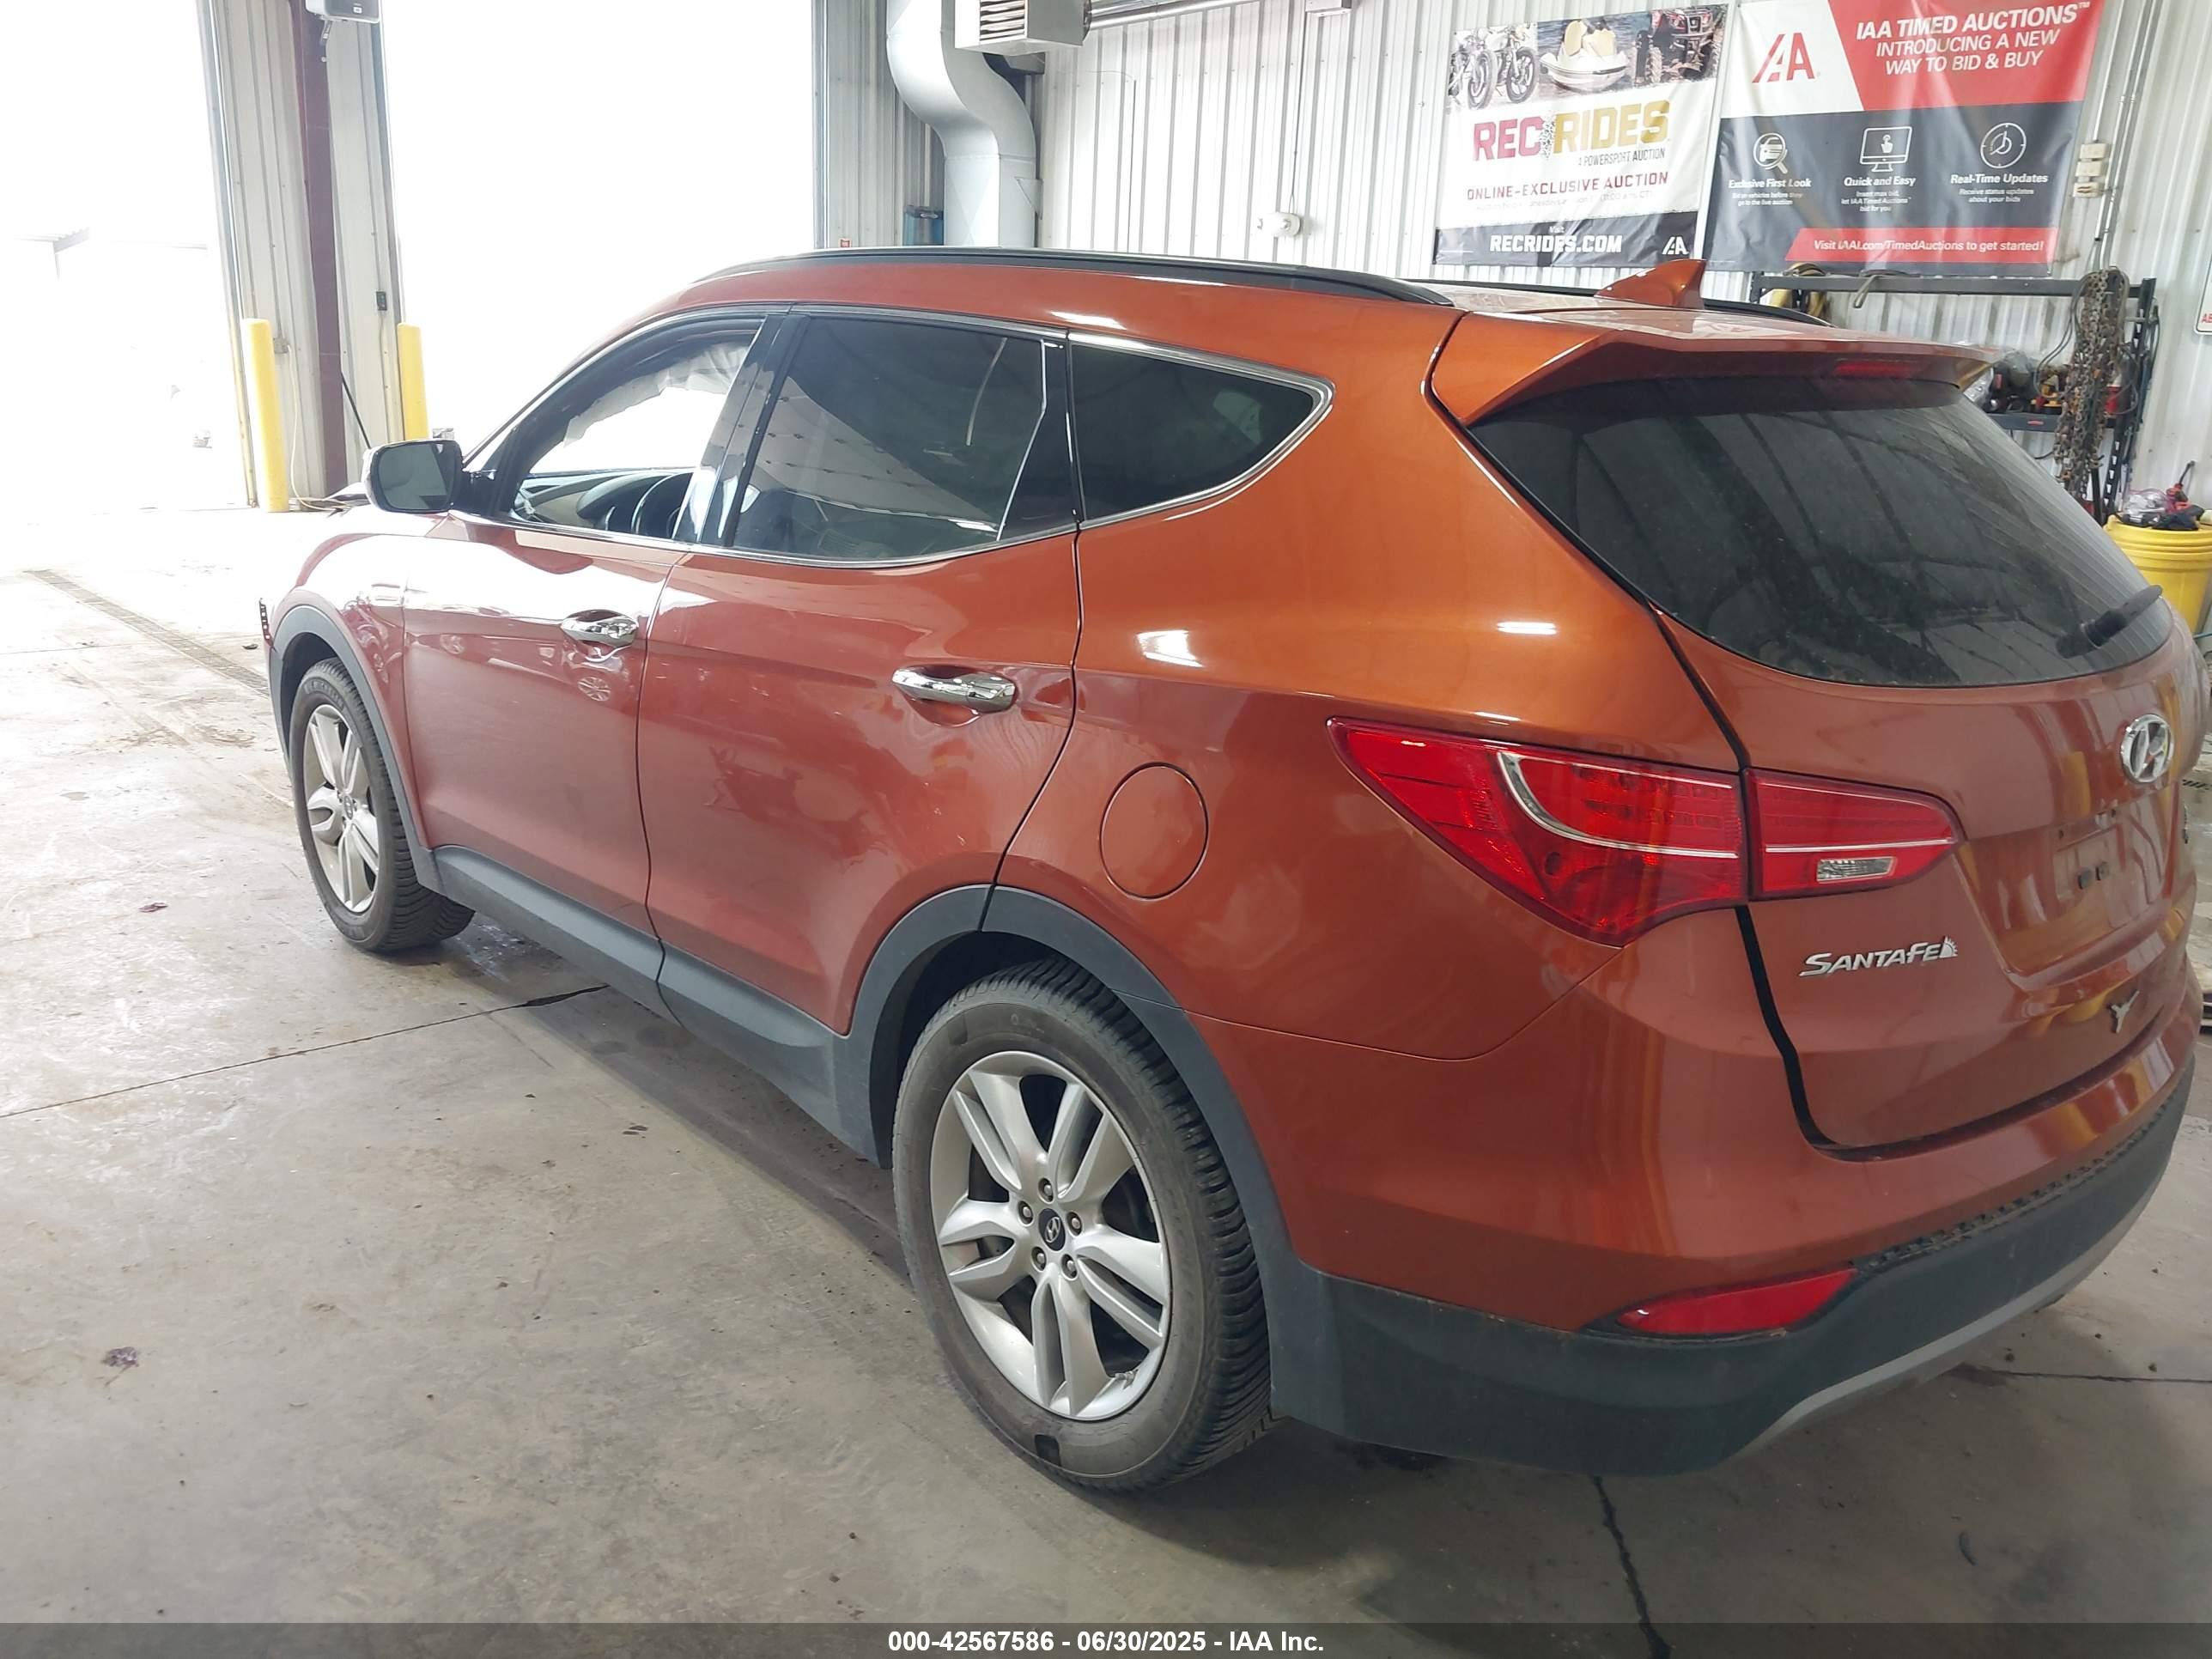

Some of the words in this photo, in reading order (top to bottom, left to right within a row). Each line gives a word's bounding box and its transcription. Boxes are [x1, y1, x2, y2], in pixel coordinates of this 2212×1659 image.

[1856, 21, 1892, 40] IAA
[1897, 15, 1957, 38] TIMED
[1876, 34, 1990, 58] INTRODUCING
[1996, 34, 2009, 49] A
[2014, 28, 2060, 47] NEW
[1886, 58, 1922, 76] WAY
[1926, 57, 1948, 73] TO
[1952, 54, 1981, 70] BID
[1985, 53, 1999, 70] &
[2004, 50, 2044, 68] BUY
[1632, 147, 1666, 161] AUCTION
[1467, 178, 1600, 201] ONLINE-EXCLUSIVE
[1604, 172, 1669, 190] AUCTION
[1766, 178, 1786, 187] First
[1788, 178, 1812, 187] Look
[1844, 176, 1872, 186] Quick
[1873, 176, 1892, 185] and
[1893, 175, 1917, 186] Easy
[1950, 173, 2001, 184] Real-Time
[2002, 173, 2049, 185] Updates
[1490, 234, 1623, 253] RECRIDES.COM
[1814, 240, 1837, 250] Visit
[1966, 240, 1977, 251] to
[1979, 240, 1998, 252] get
[1999, 240, 2045, 251] started!
